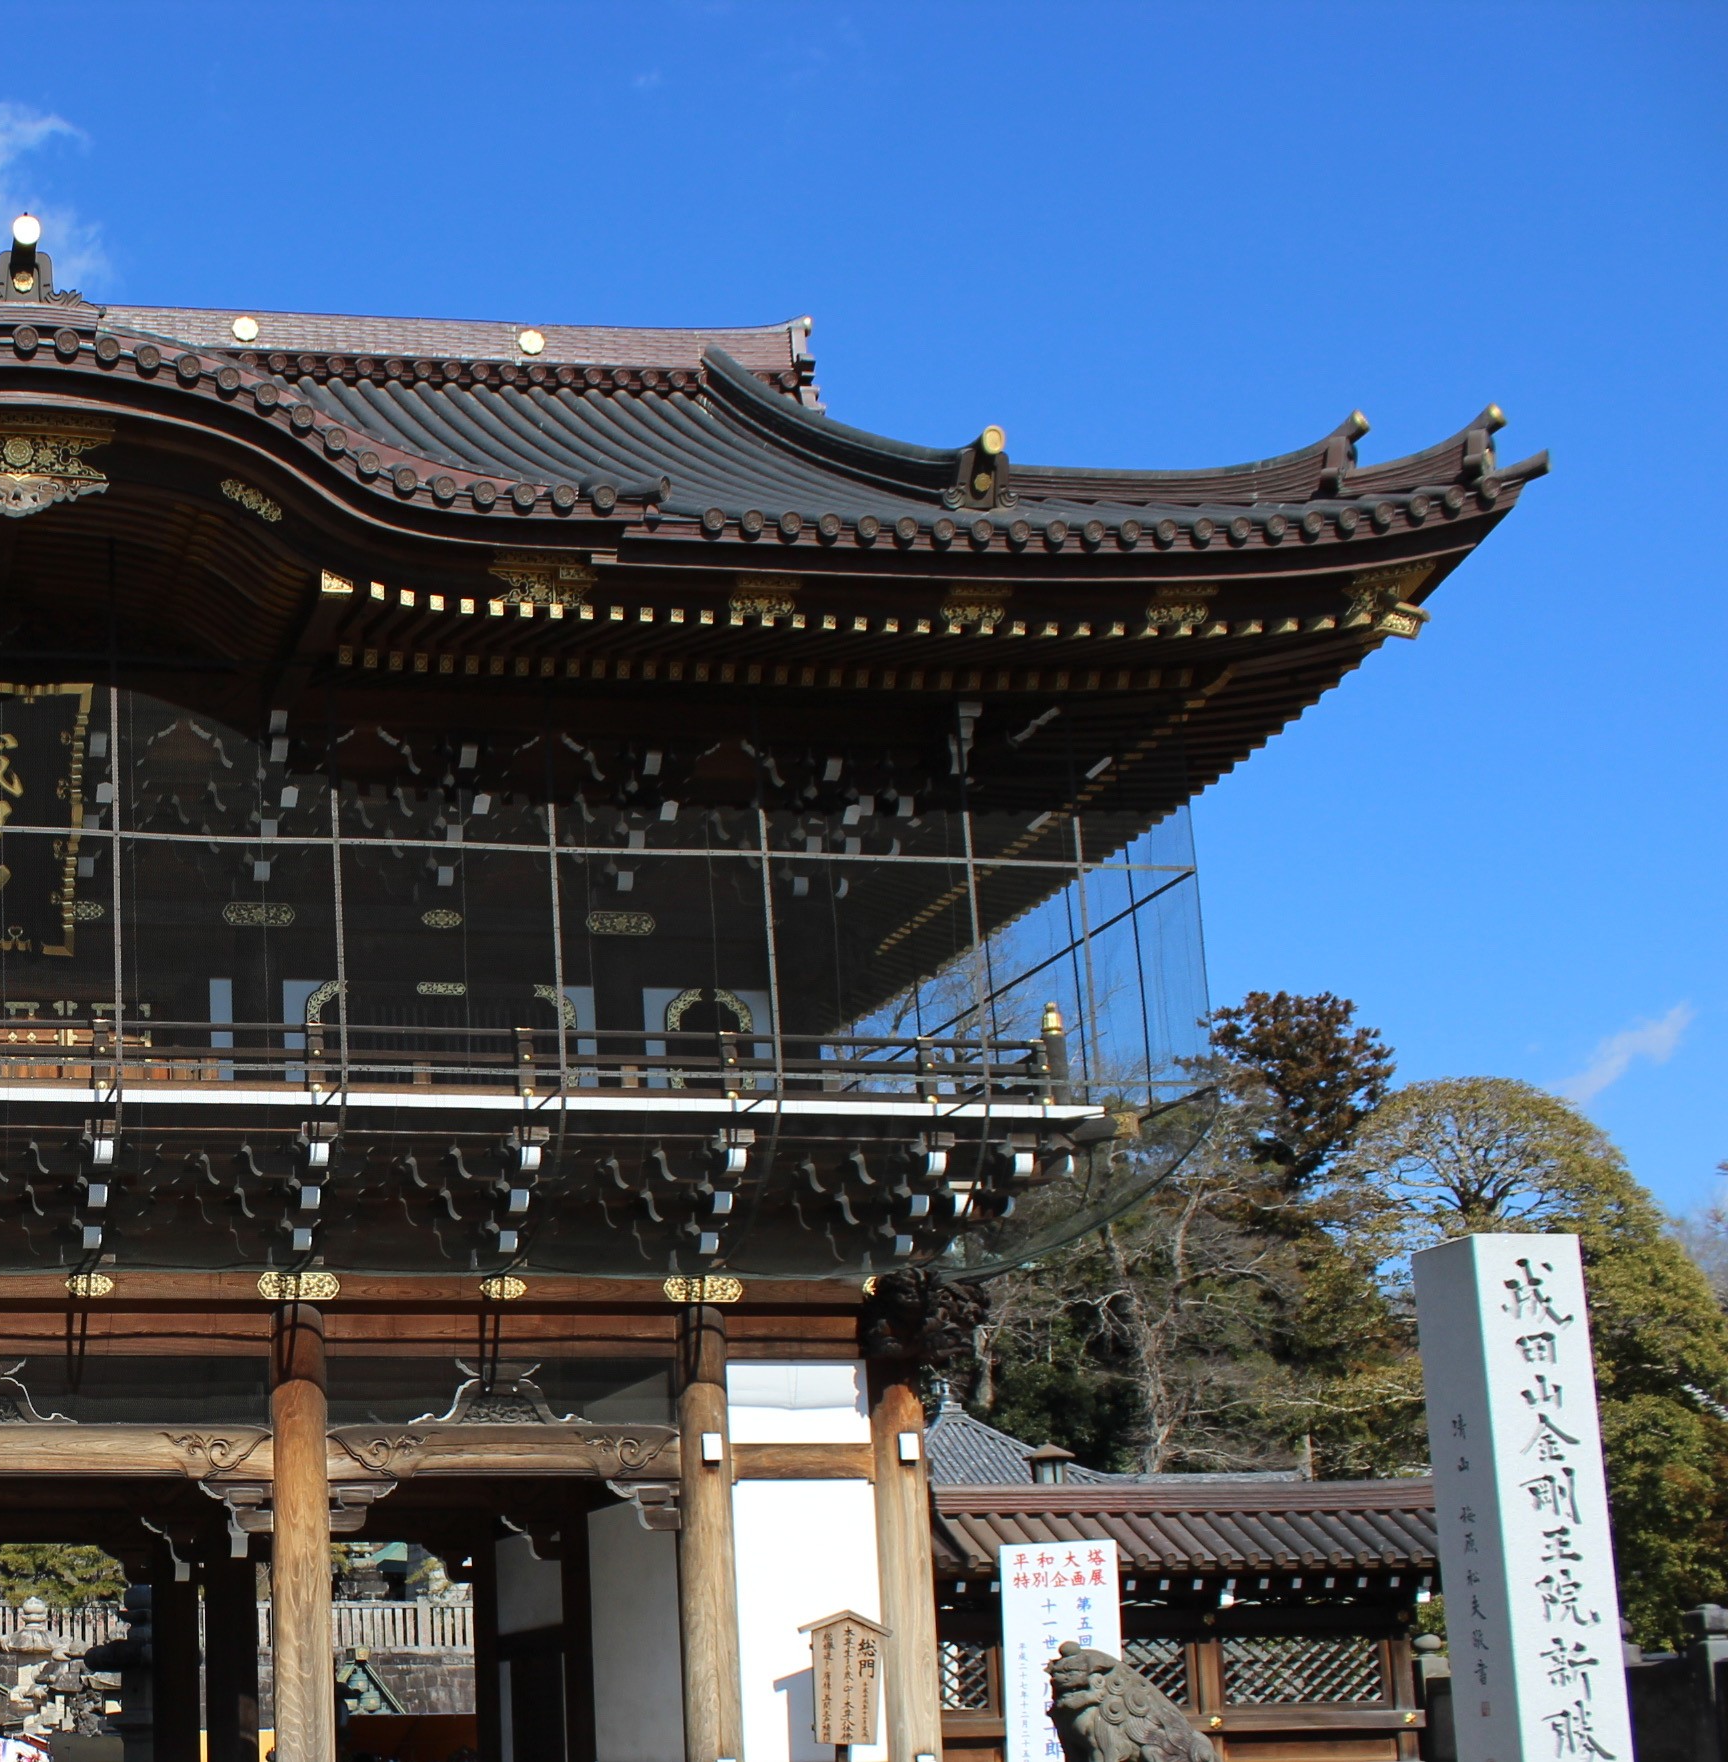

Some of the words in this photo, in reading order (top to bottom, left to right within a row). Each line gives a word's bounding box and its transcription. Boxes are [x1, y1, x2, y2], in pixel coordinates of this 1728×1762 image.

[1013, 1548, 1107, 1570] 平和大塔
[1013, 1568, 1108, 1589] 特別企画展
[1076, 1596, 1093, 1648] 第五回
[857, 1638, 877, 1679] 総門
